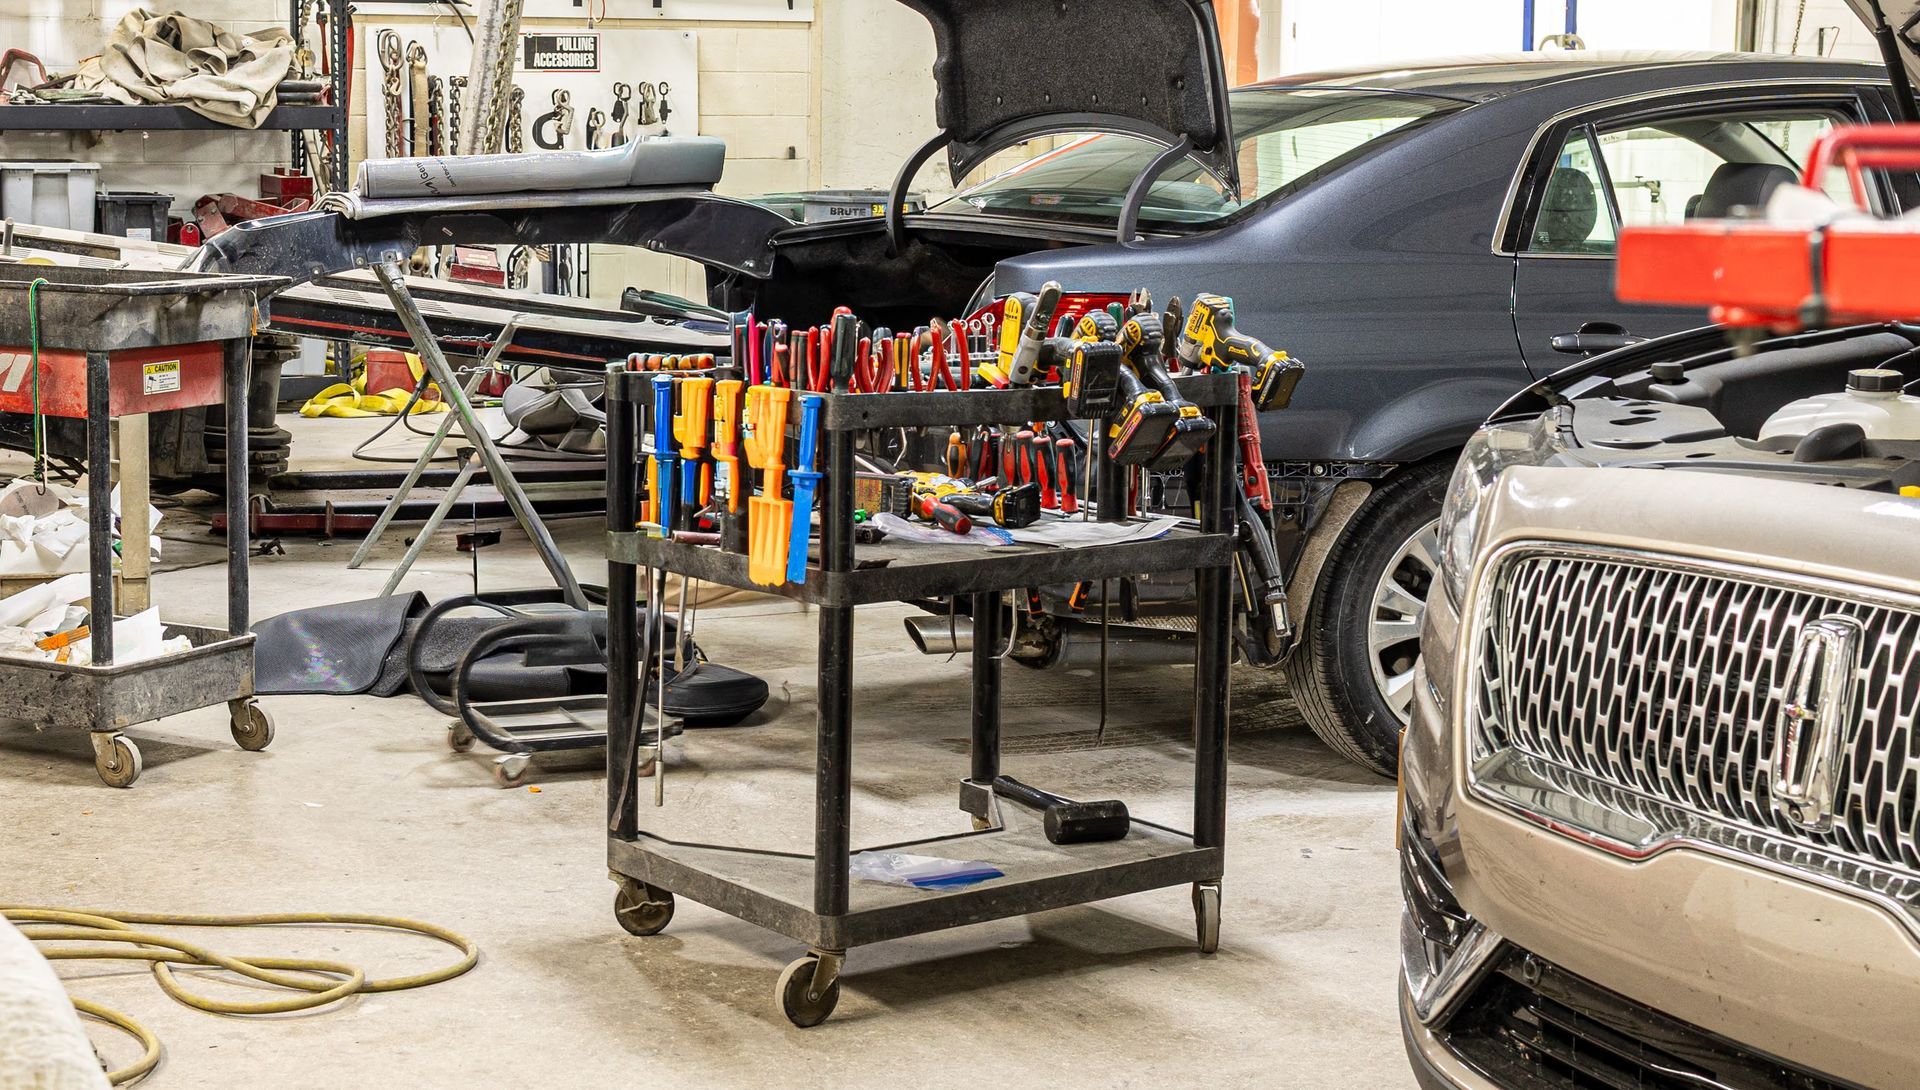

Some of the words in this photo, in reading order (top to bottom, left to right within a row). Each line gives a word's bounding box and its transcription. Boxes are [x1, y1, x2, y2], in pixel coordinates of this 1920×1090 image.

[556, 37, 594, 51] PULLING
[533, 52, 594, 67] ACCESSORIES
[830, 207, 866, 216] BRUTE
[154, 363, 177, 373] CAUTION
